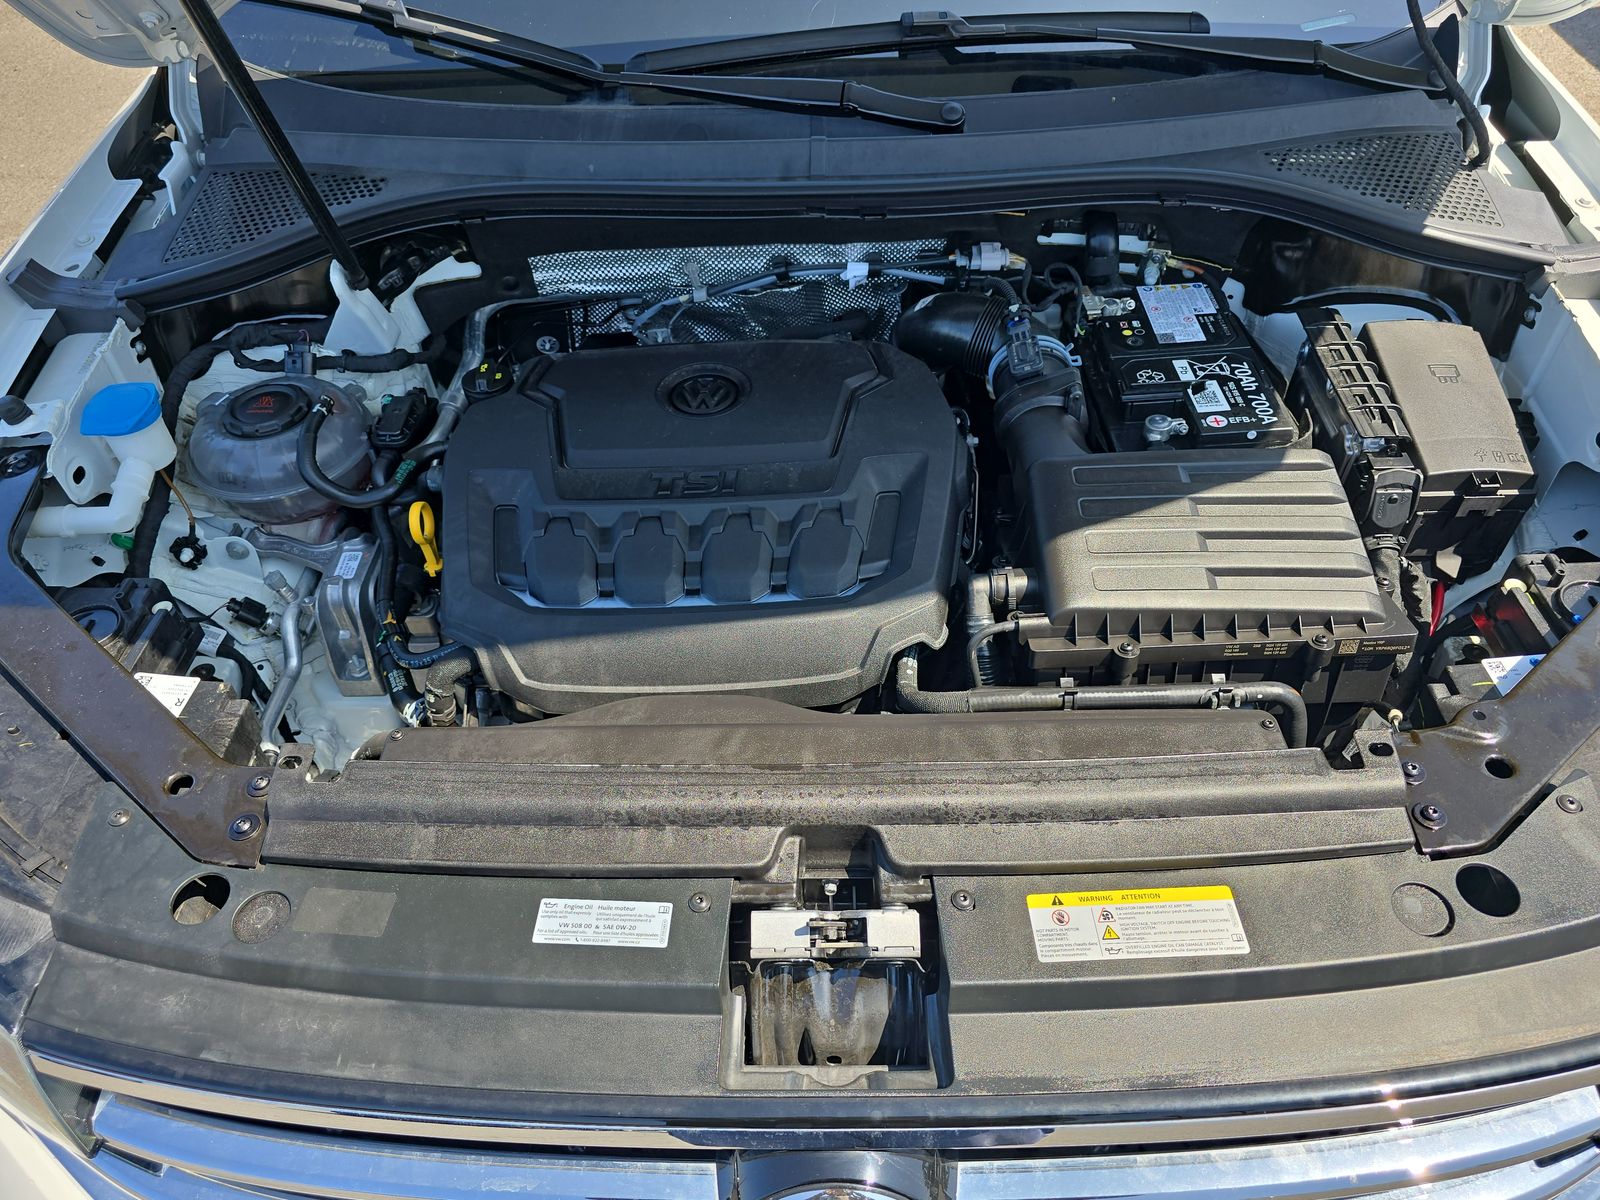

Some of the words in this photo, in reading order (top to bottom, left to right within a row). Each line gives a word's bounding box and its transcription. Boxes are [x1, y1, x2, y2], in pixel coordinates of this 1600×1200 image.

[1178, 366, 1188, 375] Pb
[1230, 362, 1259, 390] 70Ah
[1248, 393, 1278, 425] 700A
[652, 470, 739, 495] TSI
[174, 698, 185, 706] R
